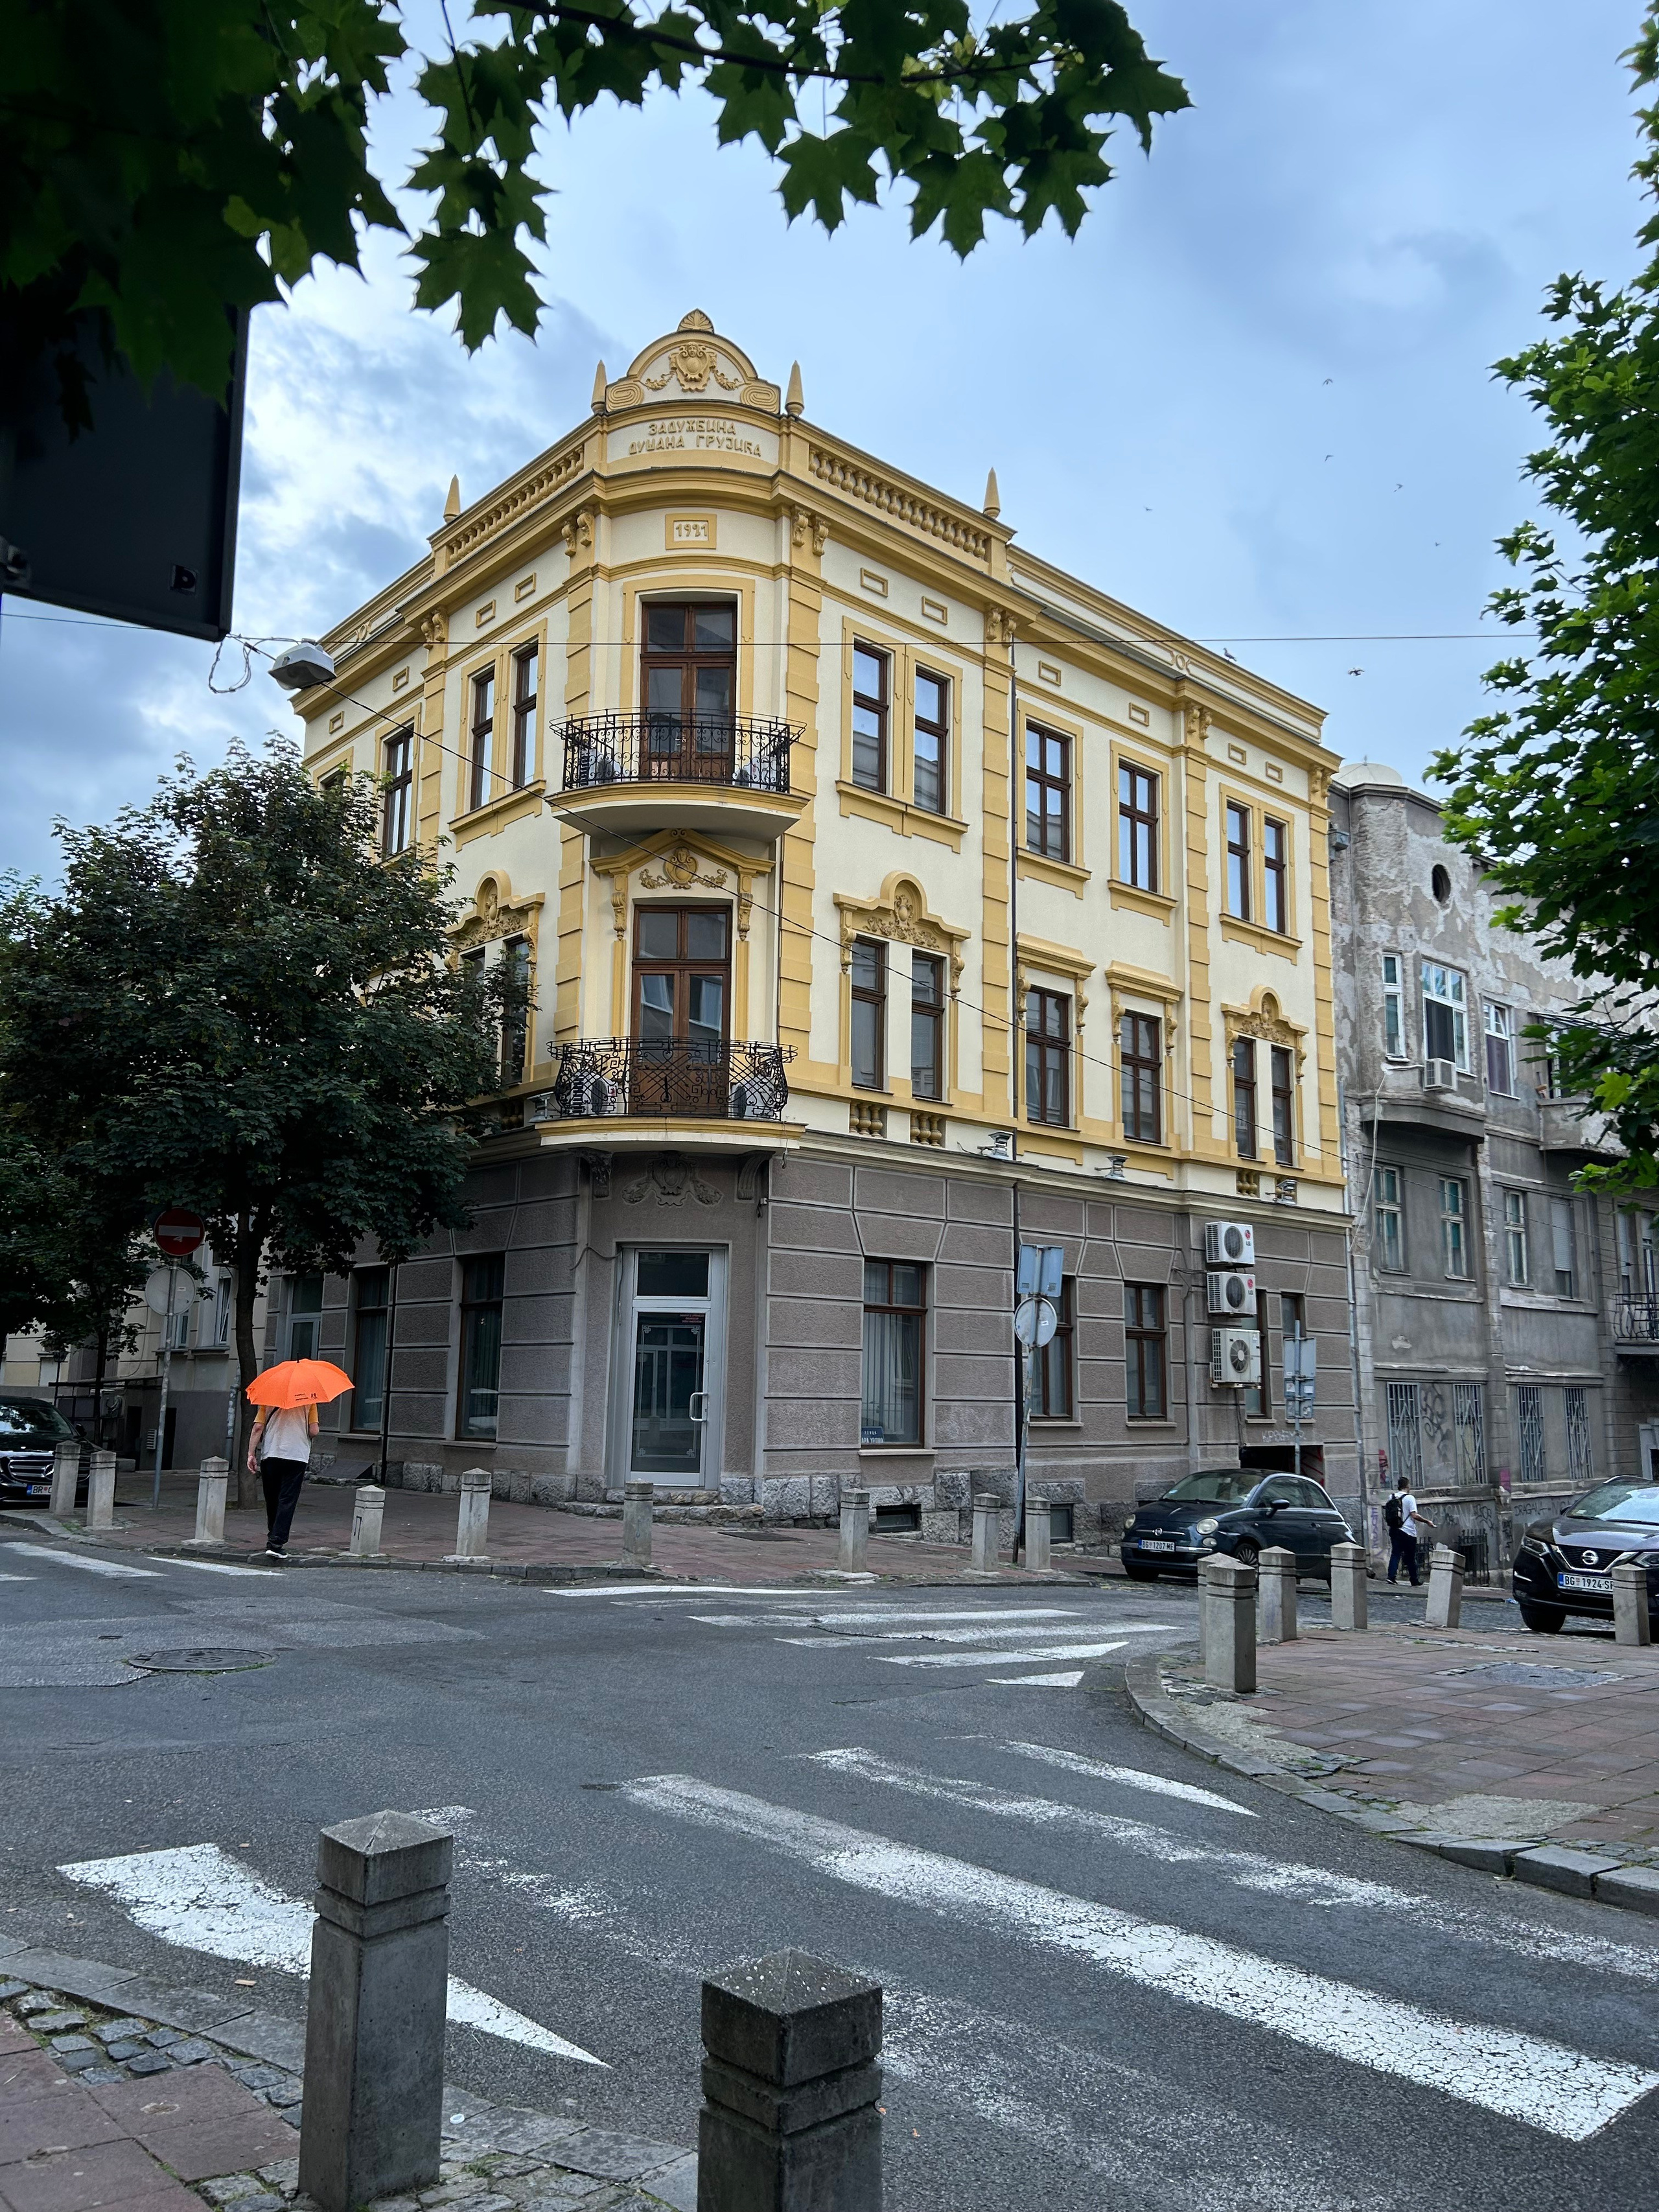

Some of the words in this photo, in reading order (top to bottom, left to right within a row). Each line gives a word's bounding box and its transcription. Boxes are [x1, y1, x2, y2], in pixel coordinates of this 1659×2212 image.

[649, 419, 736, 436] ЗАДУЖБИНА
[629, 436, 685, 454] ДУШАНА
[696, 435, 761, 457] ГРУЈИЋА
[1564, 1576, 1575, 1585] BG
